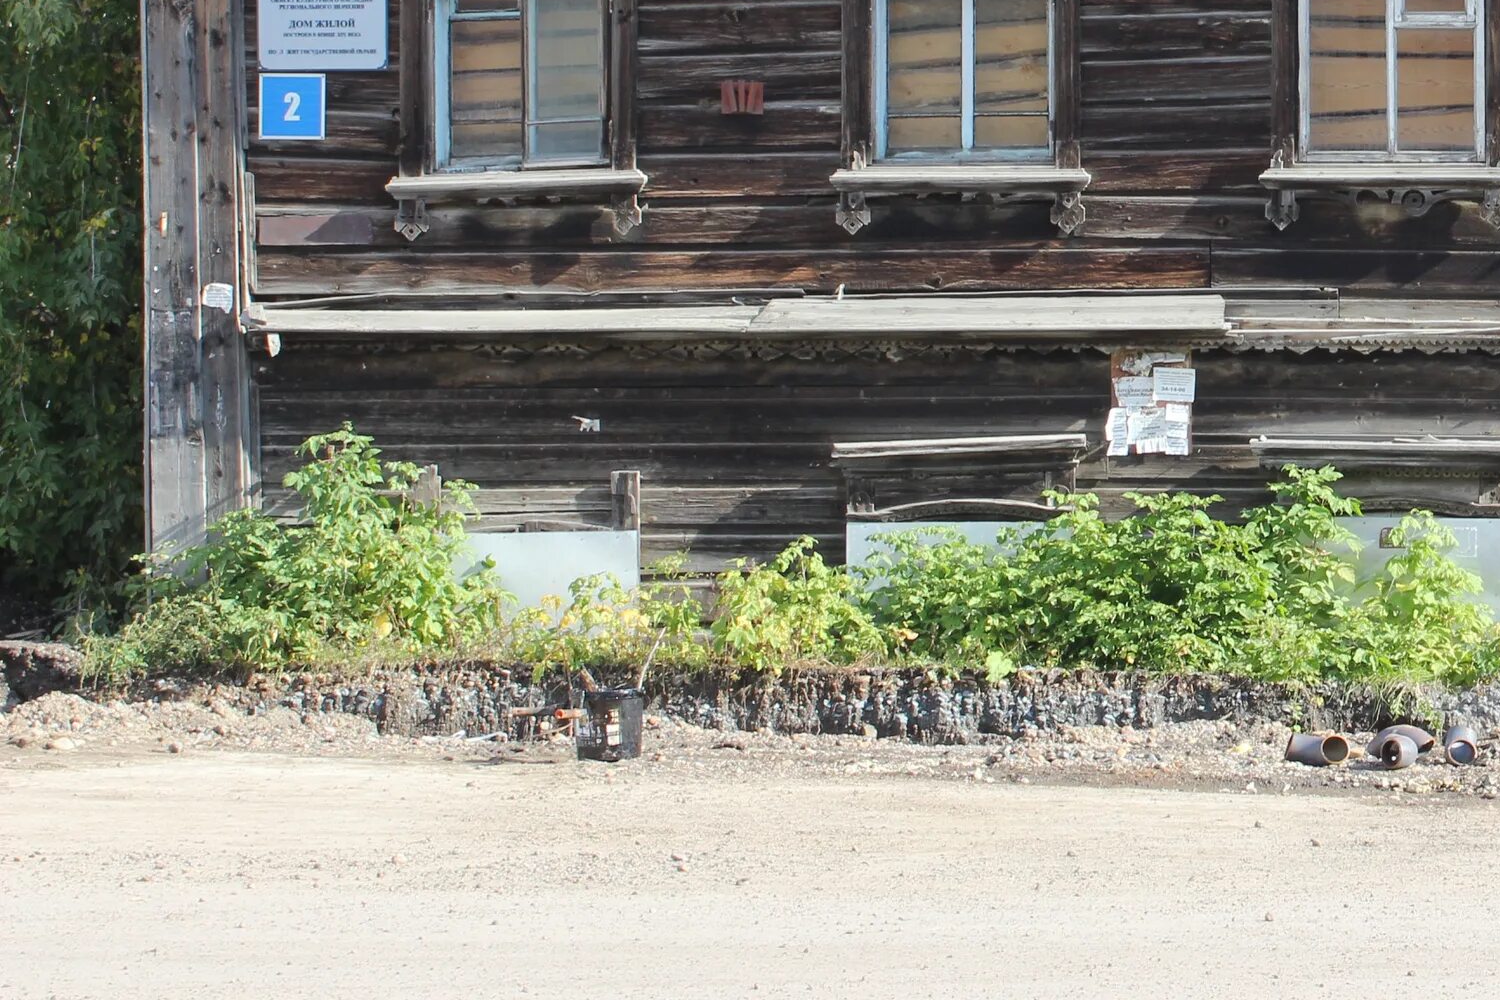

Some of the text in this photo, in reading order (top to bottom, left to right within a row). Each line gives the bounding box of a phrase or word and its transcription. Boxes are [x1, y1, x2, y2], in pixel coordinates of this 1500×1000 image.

[288, 18, 355, 29] ДОМ ЖИЛОЙ
[283, 91, 301, 122] 2
